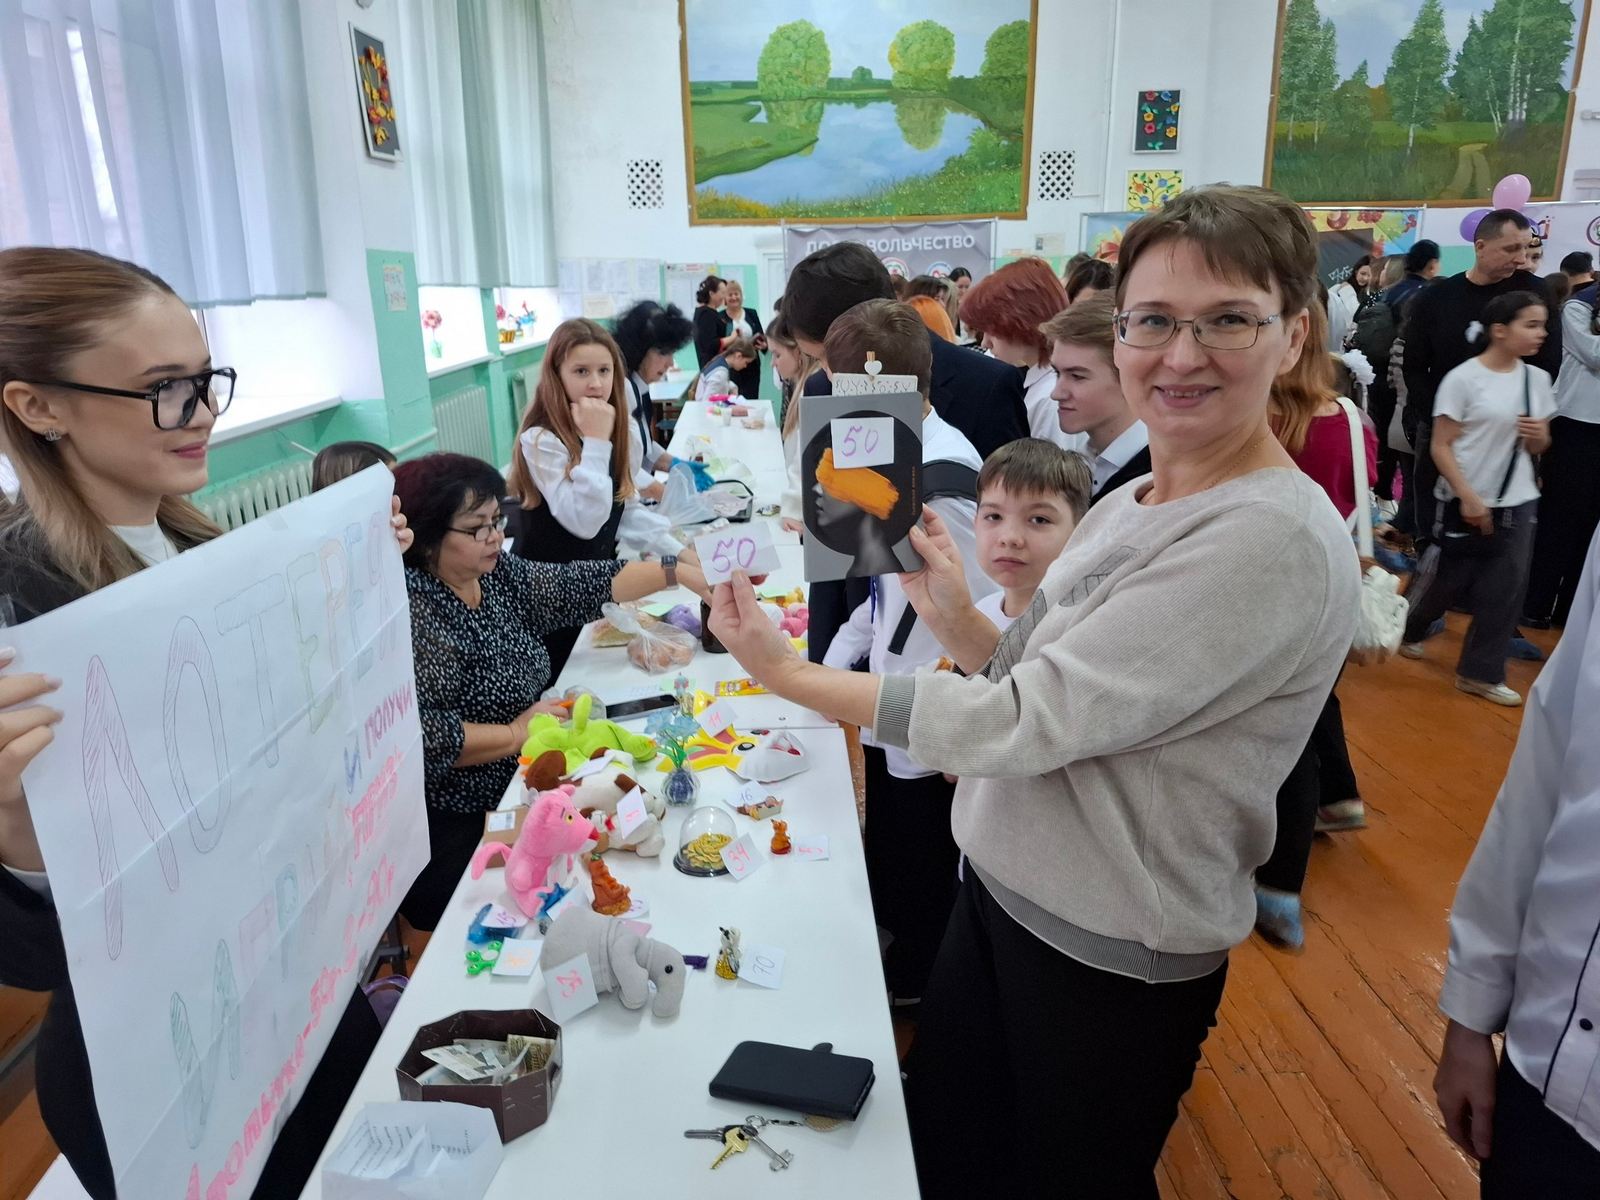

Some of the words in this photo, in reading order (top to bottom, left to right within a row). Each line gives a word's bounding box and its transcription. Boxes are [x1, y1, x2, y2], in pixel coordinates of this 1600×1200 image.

[805, 234, 975, 256] ДОВОЛЬЧЕСТВО
[840, 425, 879, 458] 50
[712, 537, 756, 574] 50
[82, 511, 396, 961] ЛОТЕРЕЯ
[343, 734, 362, 795] И
[364, 680, 413, 760] ПОЛУЧИ
[739, 788, 753, 804] 16
[727, 842, 751, 873] 34
[752, 955, 776, 976] 70
[556, 969, 584, 999] 25
